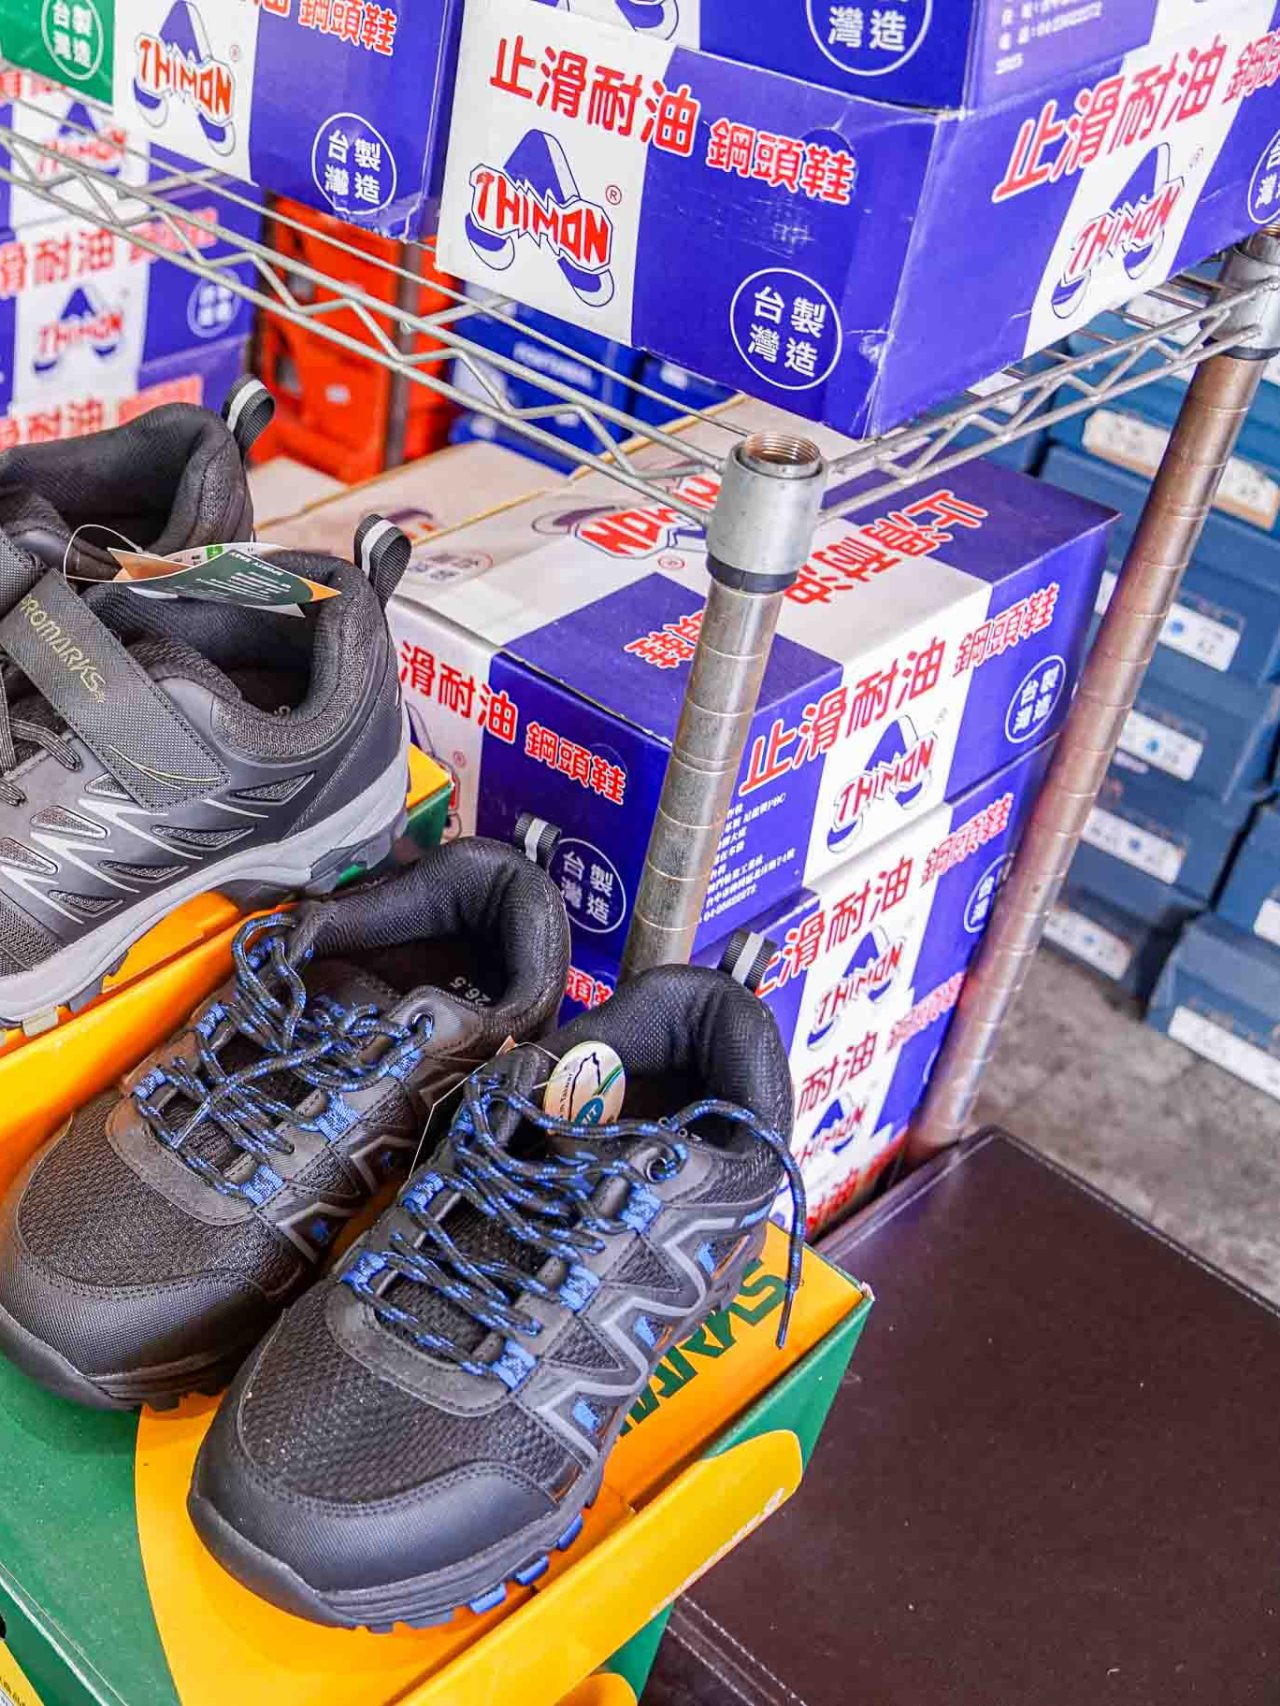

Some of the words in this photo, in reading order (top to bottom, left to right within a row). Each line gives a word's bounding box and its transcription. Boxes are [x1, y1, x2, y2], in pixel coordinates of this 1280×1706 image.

[138, 38, 233, 116] THIMON
[489, 34, 700, 156] 止滑耐油
[705, 117, 856, 204] 鋼頭鞋
[992, 34, 1227, 202] 止滑耐油
[475, 171, 609, 265] THIMON
[1069, 183, 1182, 278] THIMON
[738, 636, 947, 797] 止滑耐油
[952, 582, 1059, 679] 鋼頭鞋
[524, 721, 626, 806] 鋼頭鞋
[838, 737, 935, 822] THIMON
[449, 976, 492, 1007] 26.5
[817, 943, 903, 1025] THIMON
